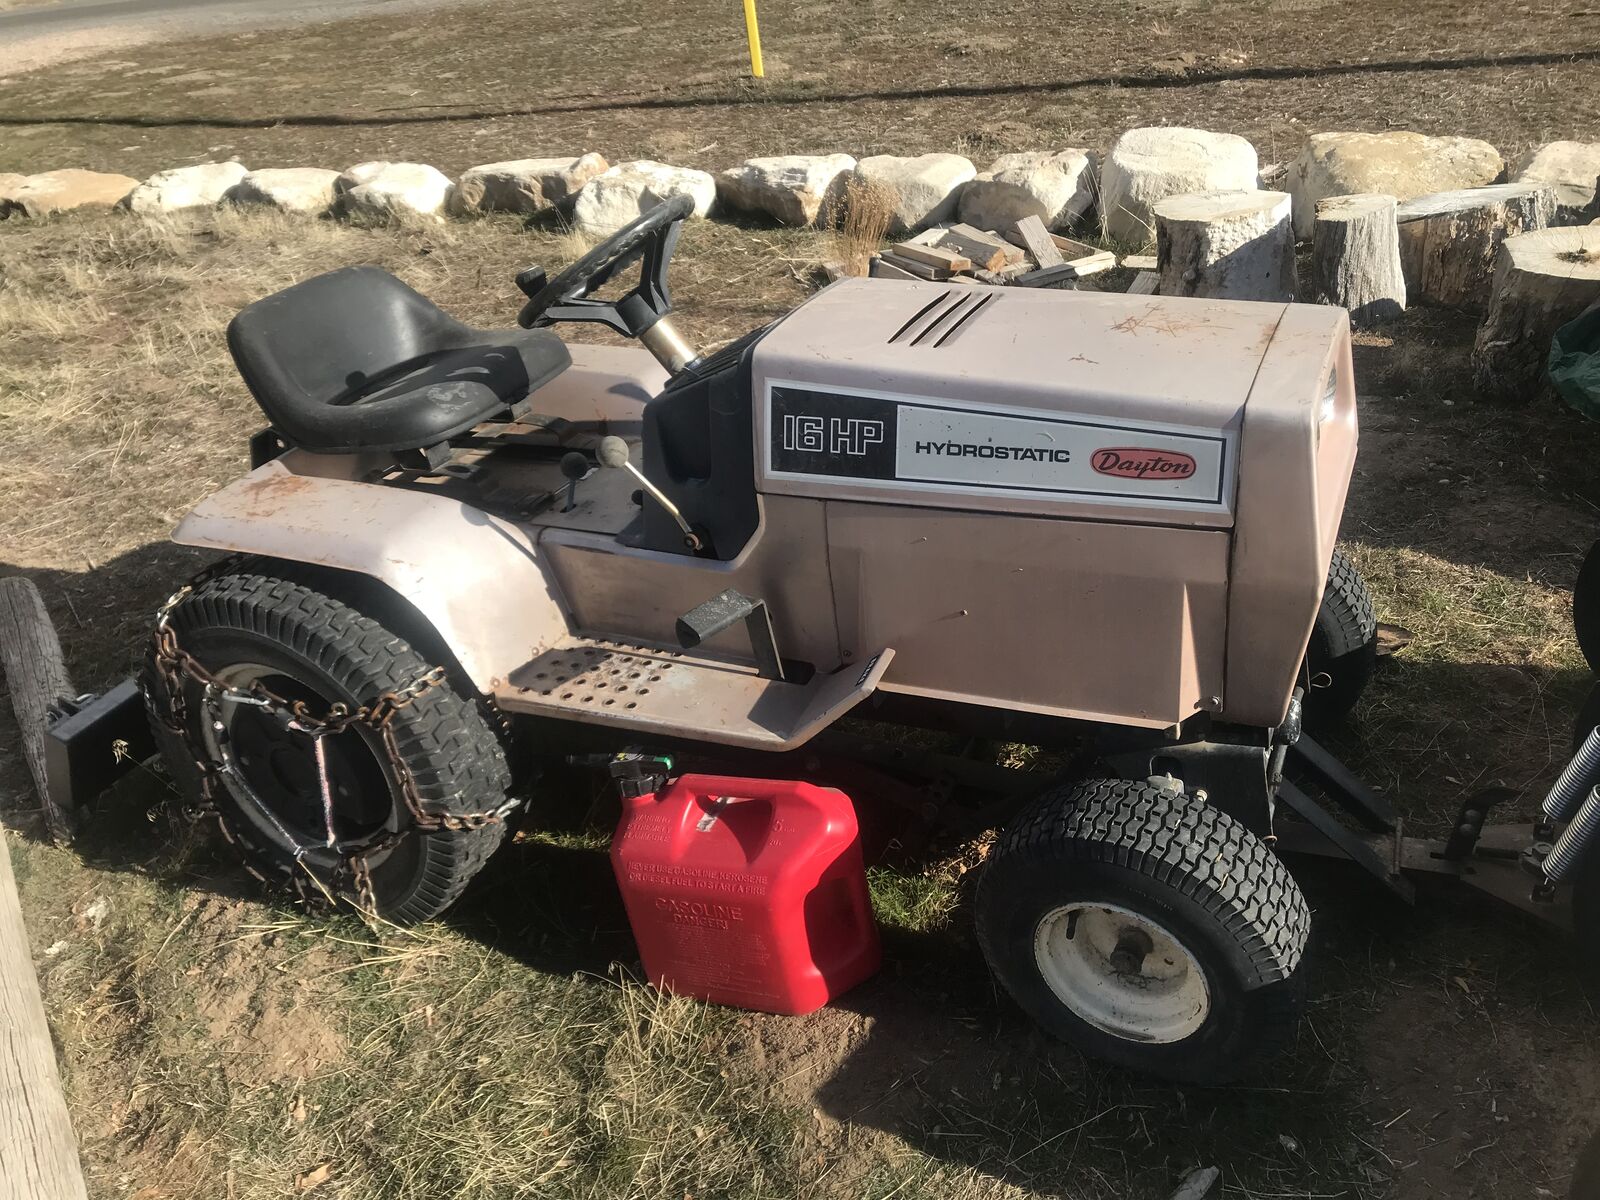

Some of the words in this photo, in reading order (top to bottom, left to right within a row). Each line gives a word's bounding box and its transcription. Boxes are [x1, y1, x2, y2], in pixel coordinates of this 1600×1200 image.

[784, 414, 824, 452] 16
[830, 417, 884, 456] HP
[915, 441, 1071, 463] HYDROSTATIC
[1098, 452, 1191, 478] Dayton
[628, 861, 656, 873] NEVER
[656, 864, 672, 874] USE
[719, 872, 768, 885] KEROSENE
[629, 872, 641, 881] OR
[642, 873, 671, 885] DIESEL
[671, 878, 693, 887] FUEL
[695, 880, 706, 889] TO
[707, 881, 736, 893] START
[736, 884, 744, 893] A
[745, 886, 766, 896] FIRE
[655, 897, 744, 921] GASOLINE
[673, 914, 729, 930] DANGER!
